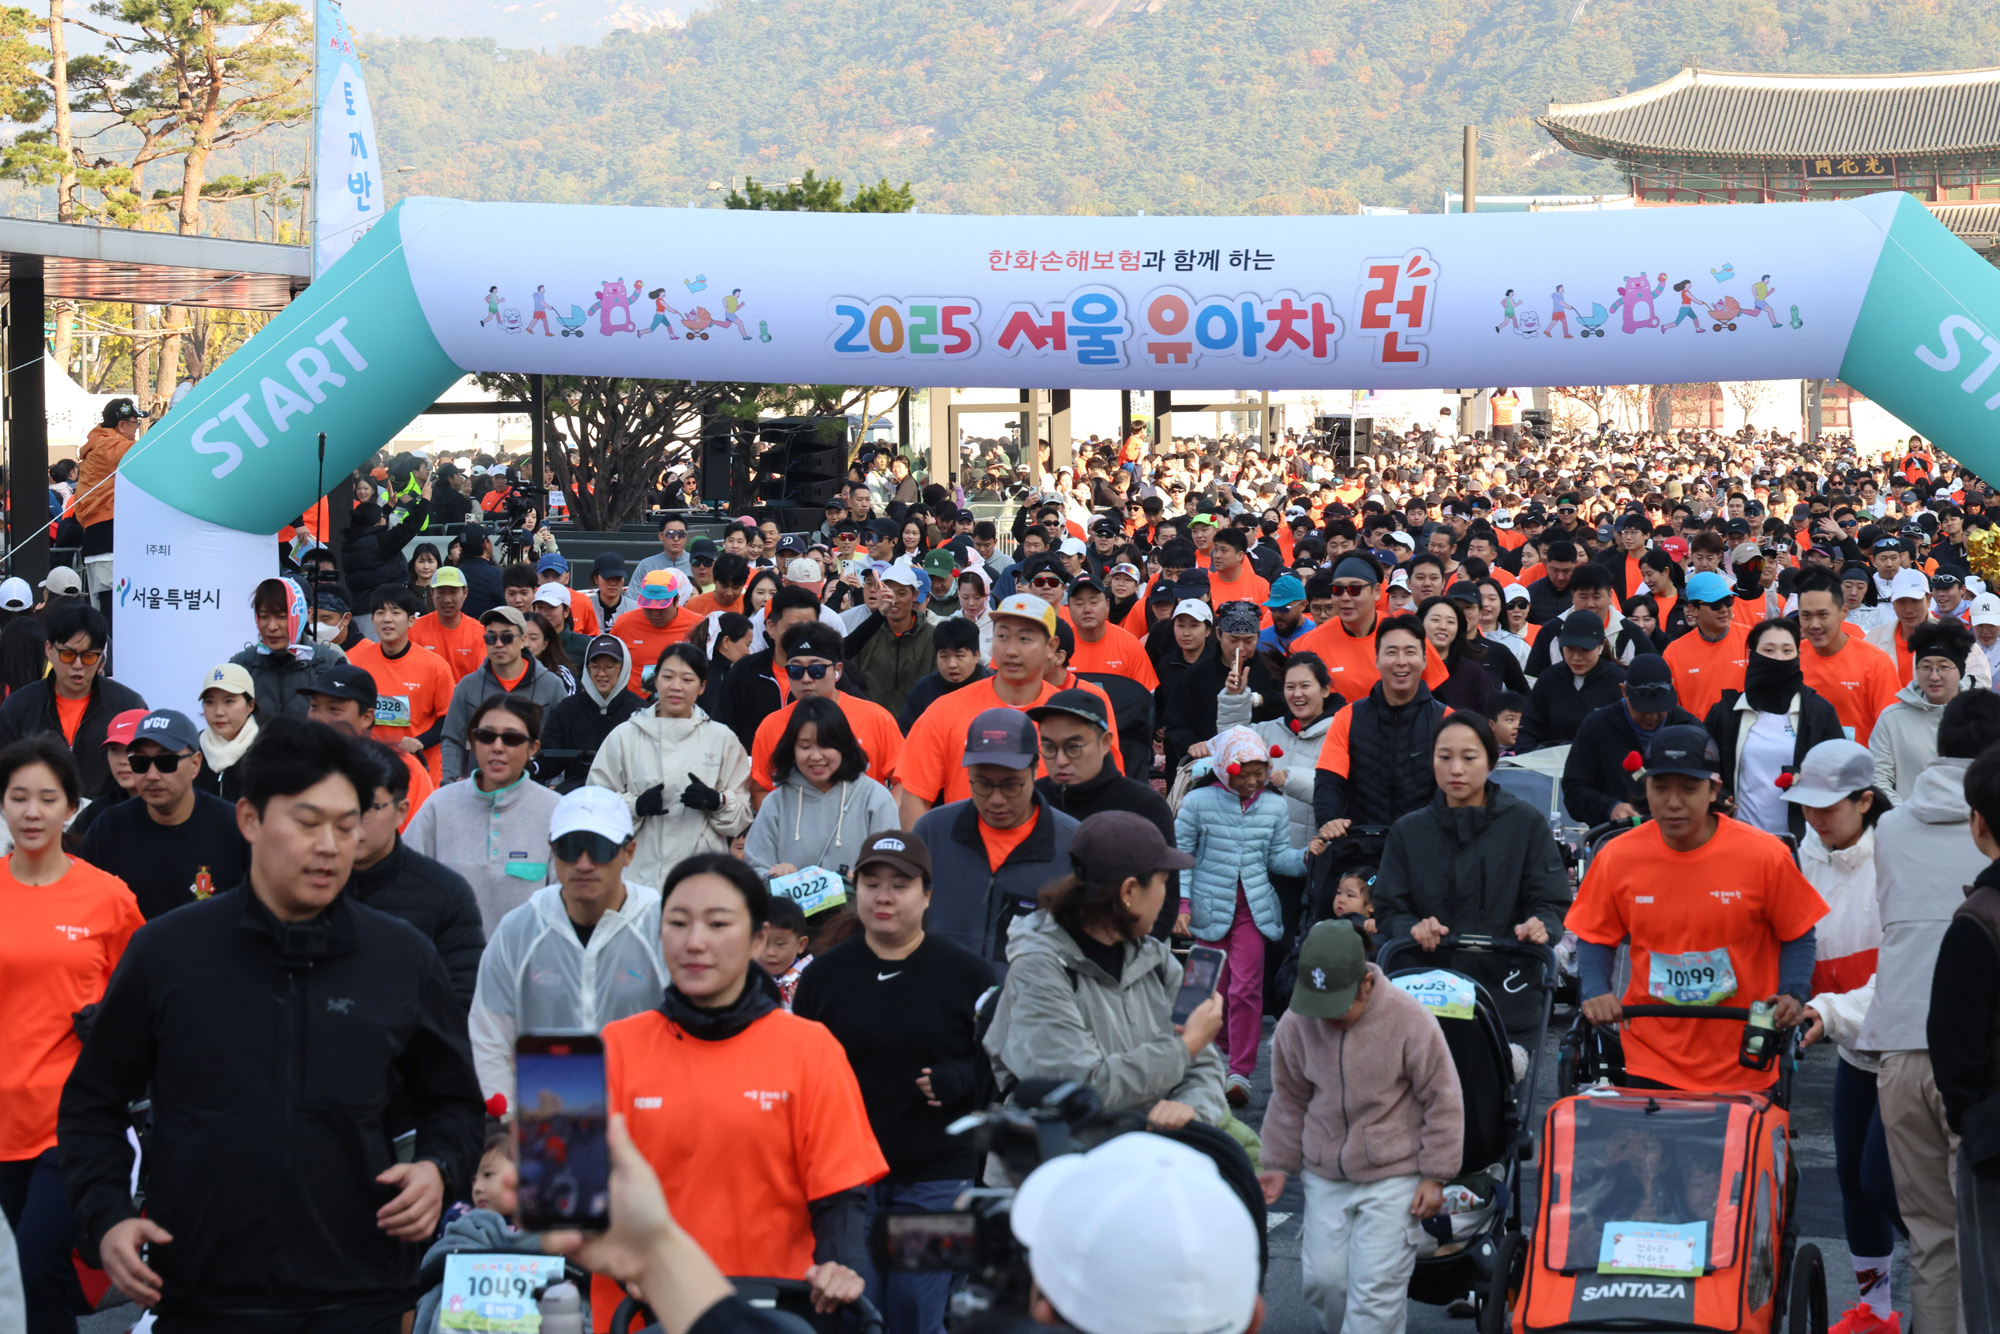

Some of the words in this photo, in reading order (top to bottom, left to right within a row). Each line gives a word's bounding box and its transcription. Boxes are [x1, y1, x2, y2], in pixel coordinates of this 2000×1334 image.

[344, 81, 371, 212] 토끼반
[988, 250, 1166, 272] 한화손해보험과
[1174, 249, 1220, 272] 함께
[1228, 249, 1275, 271] 하는
[834, 304, 972, 355] 2025
[998, 292, 1124, 365] 서울
[1147, 294, 1335, 364] 유아차
[1360, 255, 1431, 363] 런
[190, 315, 369, 480] START
[782, 534, 794, 546] D
[132, 587, 220, 610] 서울특별시
[213, 669, 225, 681] LA
[375, 700, 402, 712] 0328
[143, 716, 171, 730] WGU
[785, 876, 829, 899] 10222
[1666, 966, 1715, 987] 10199
[1581, 1282, 1686, 1302] SANTAZA
